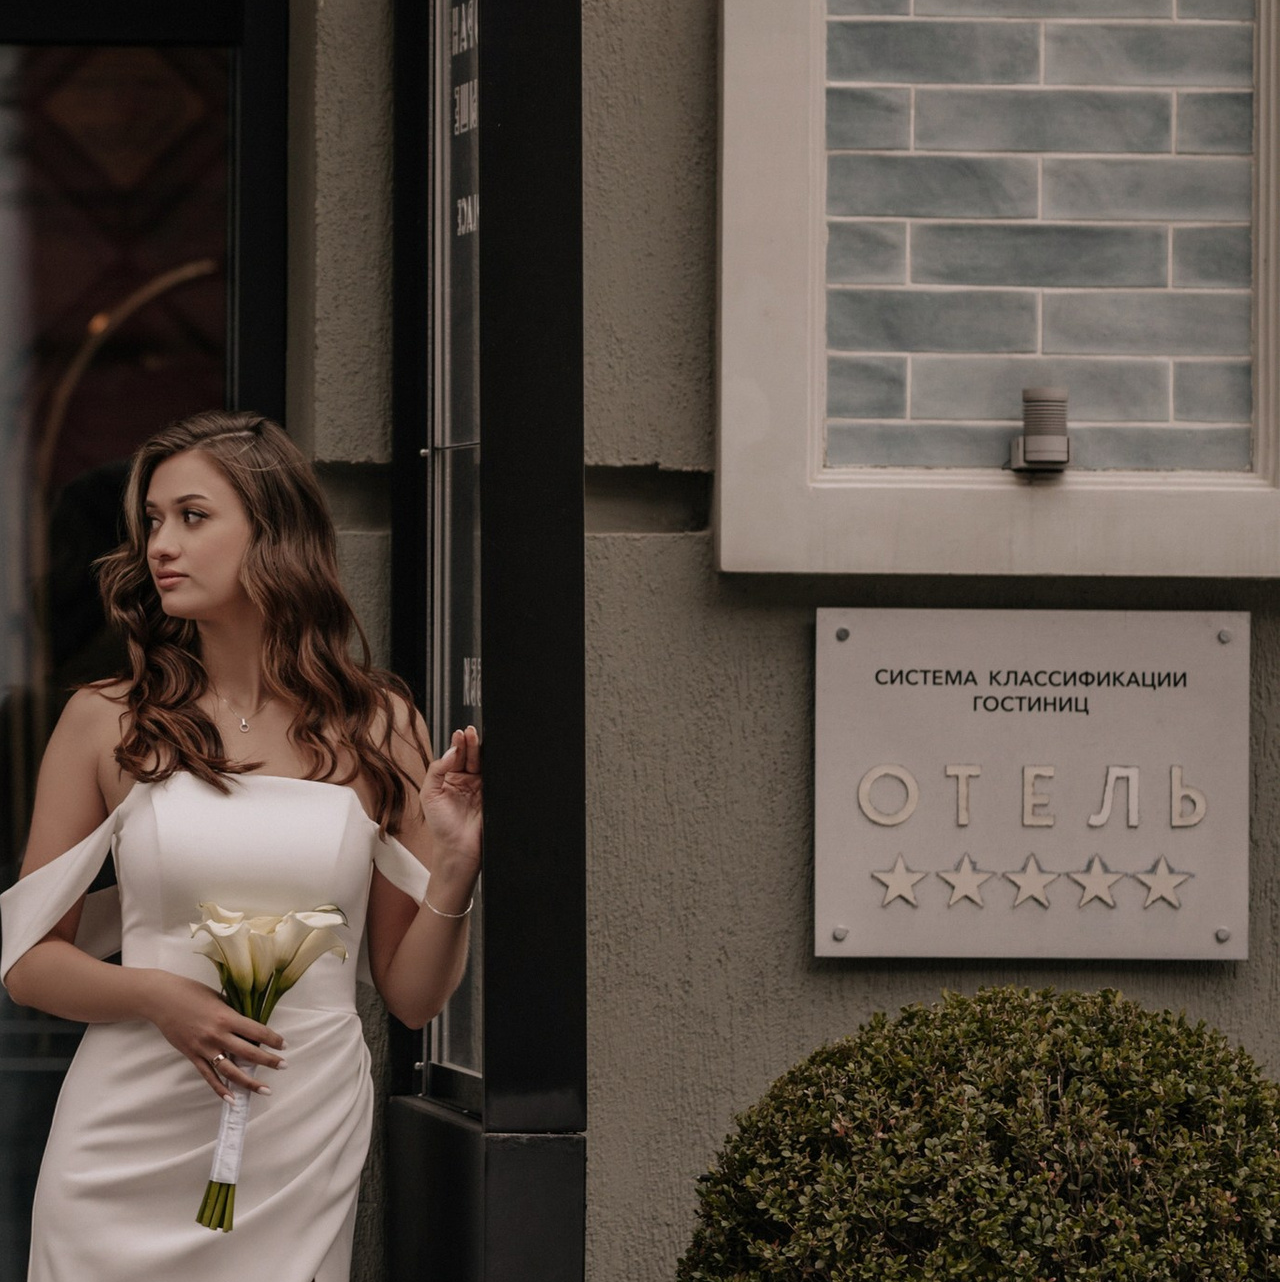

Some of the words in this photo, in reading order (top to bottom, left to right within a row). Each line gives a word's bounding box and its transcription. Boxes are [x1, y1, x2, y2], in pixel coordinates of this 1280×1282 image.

[874, 668, 978, 687] СИСТЕМА
[989, 669, 1188, 691] КЛАССИФИКАЦИИ
[972, 696, 1090, 716] ГОСТИНИЦ
[857, 763, 1208, 828] ОТЕЛЬ
